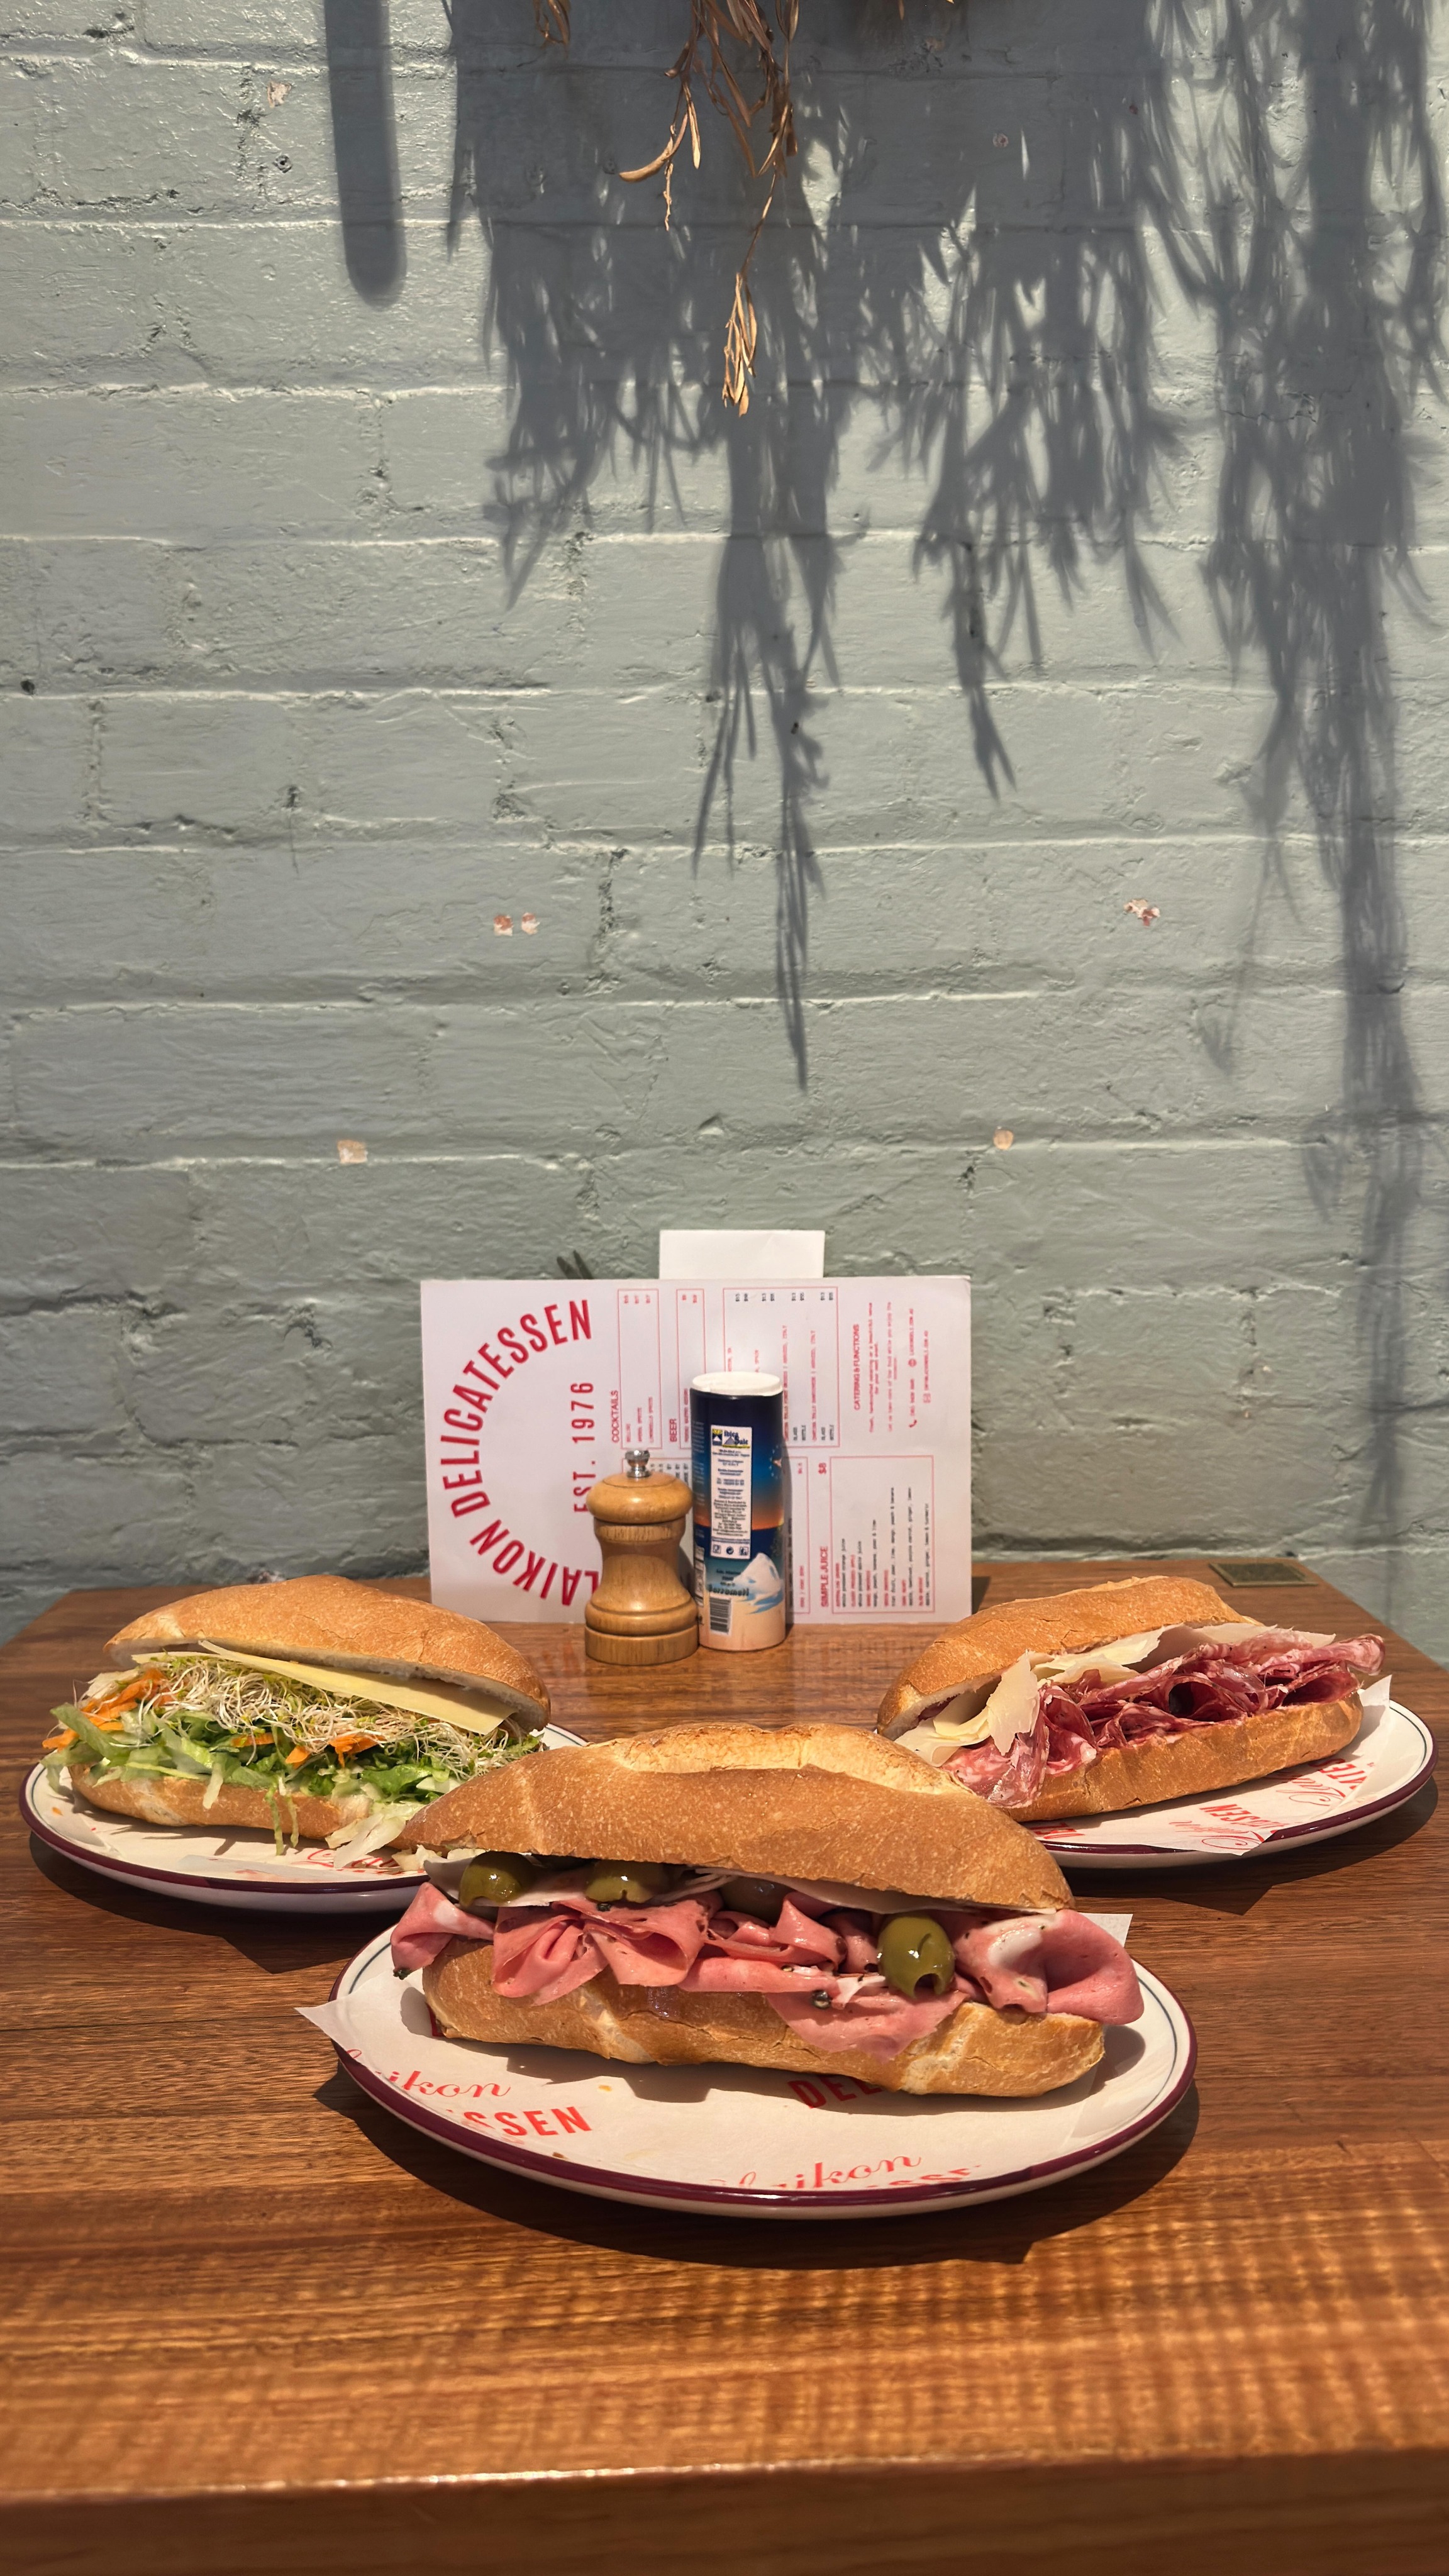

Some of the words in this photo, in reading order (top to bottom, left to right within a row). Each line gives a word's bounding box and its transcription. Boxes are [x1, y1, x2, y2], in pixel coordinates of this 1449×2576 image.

[440, 1299, 593, 1518] DELICATESSEN
[570, 1382, 595, 1443] 1976
[611, 1390, 619, 1443] COCKTAILS
[669, 1418, 677, 1442] BEER
[818, 1462, 827, 1474] $8
[470, 1519, 599, 1606] LAIKON
[819, 1546, 828, 1573] JUICE
[820, 1575, 828, 1607] SIMPLE
[446, 2106, 592, 2136] SSEN
[739, 2155, 922, 2189] ikon
